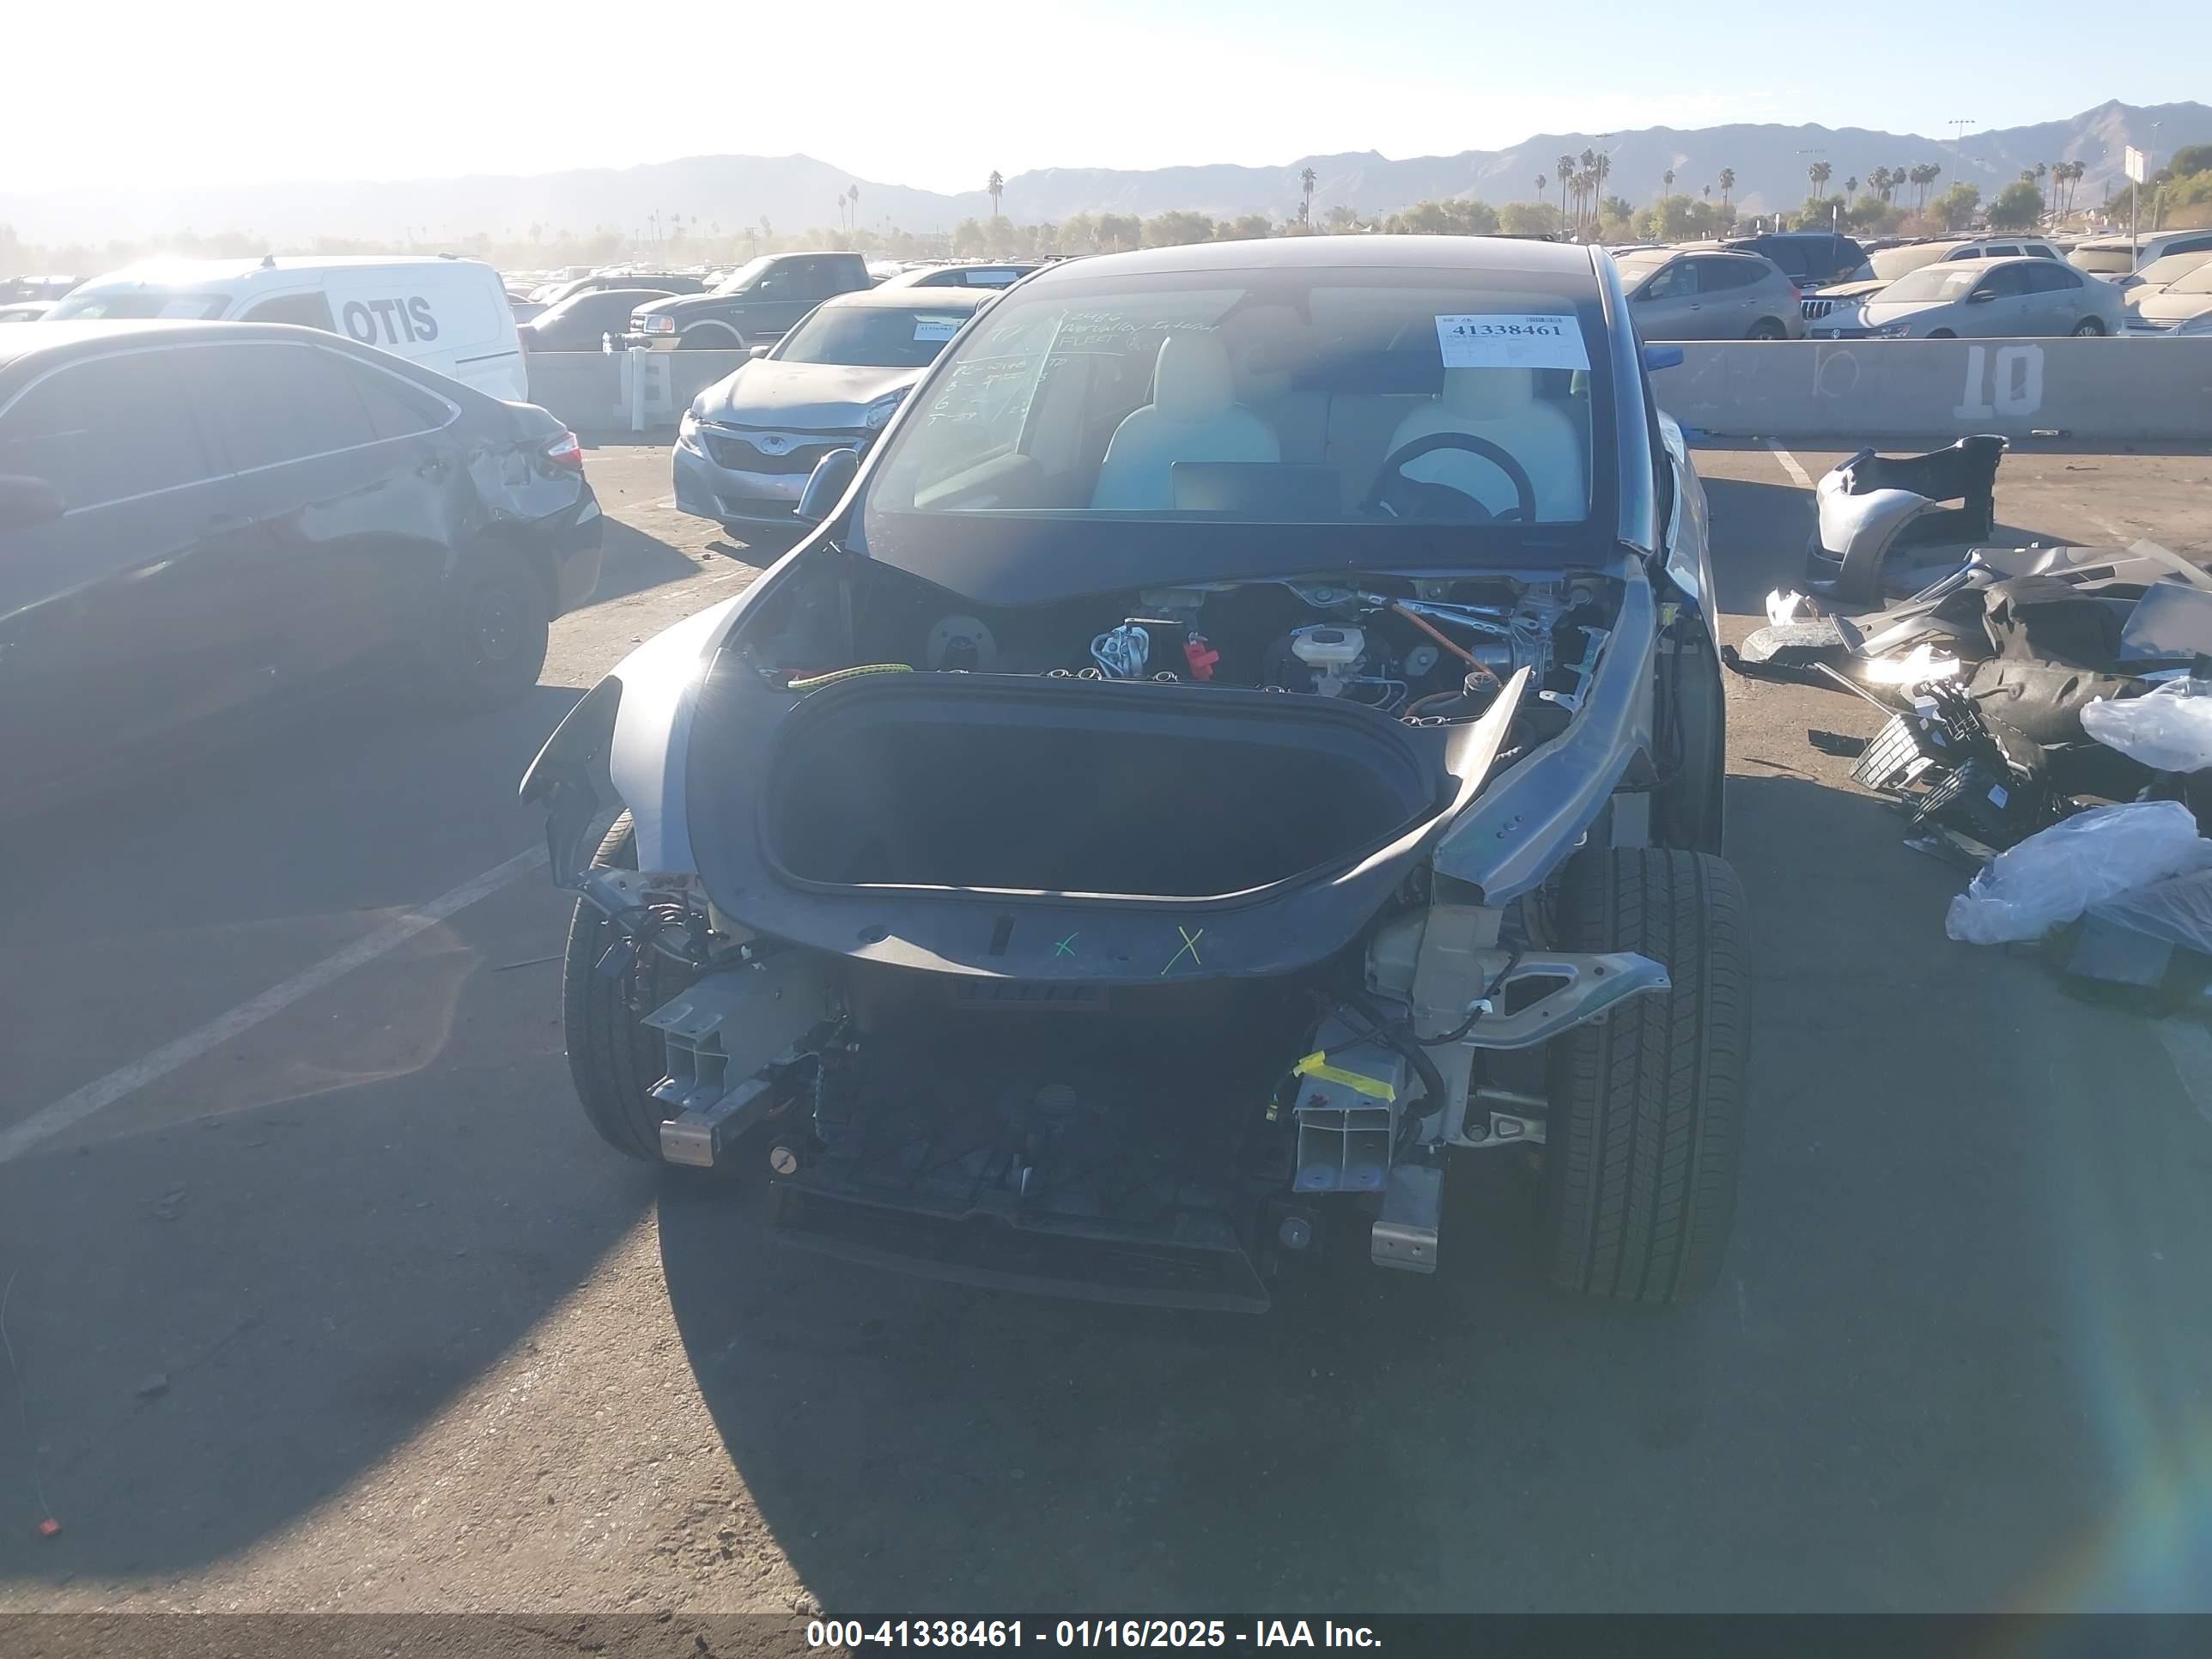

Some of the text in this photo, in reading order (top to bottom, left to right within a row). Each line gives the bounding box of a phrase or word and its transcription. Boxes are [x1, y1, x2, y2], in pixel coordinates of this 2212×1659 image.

[343, 295, 438, 345] OTIS
[1452, 325, 1562, 336] 41338461
[1953, 343, 2045, 419] 10
